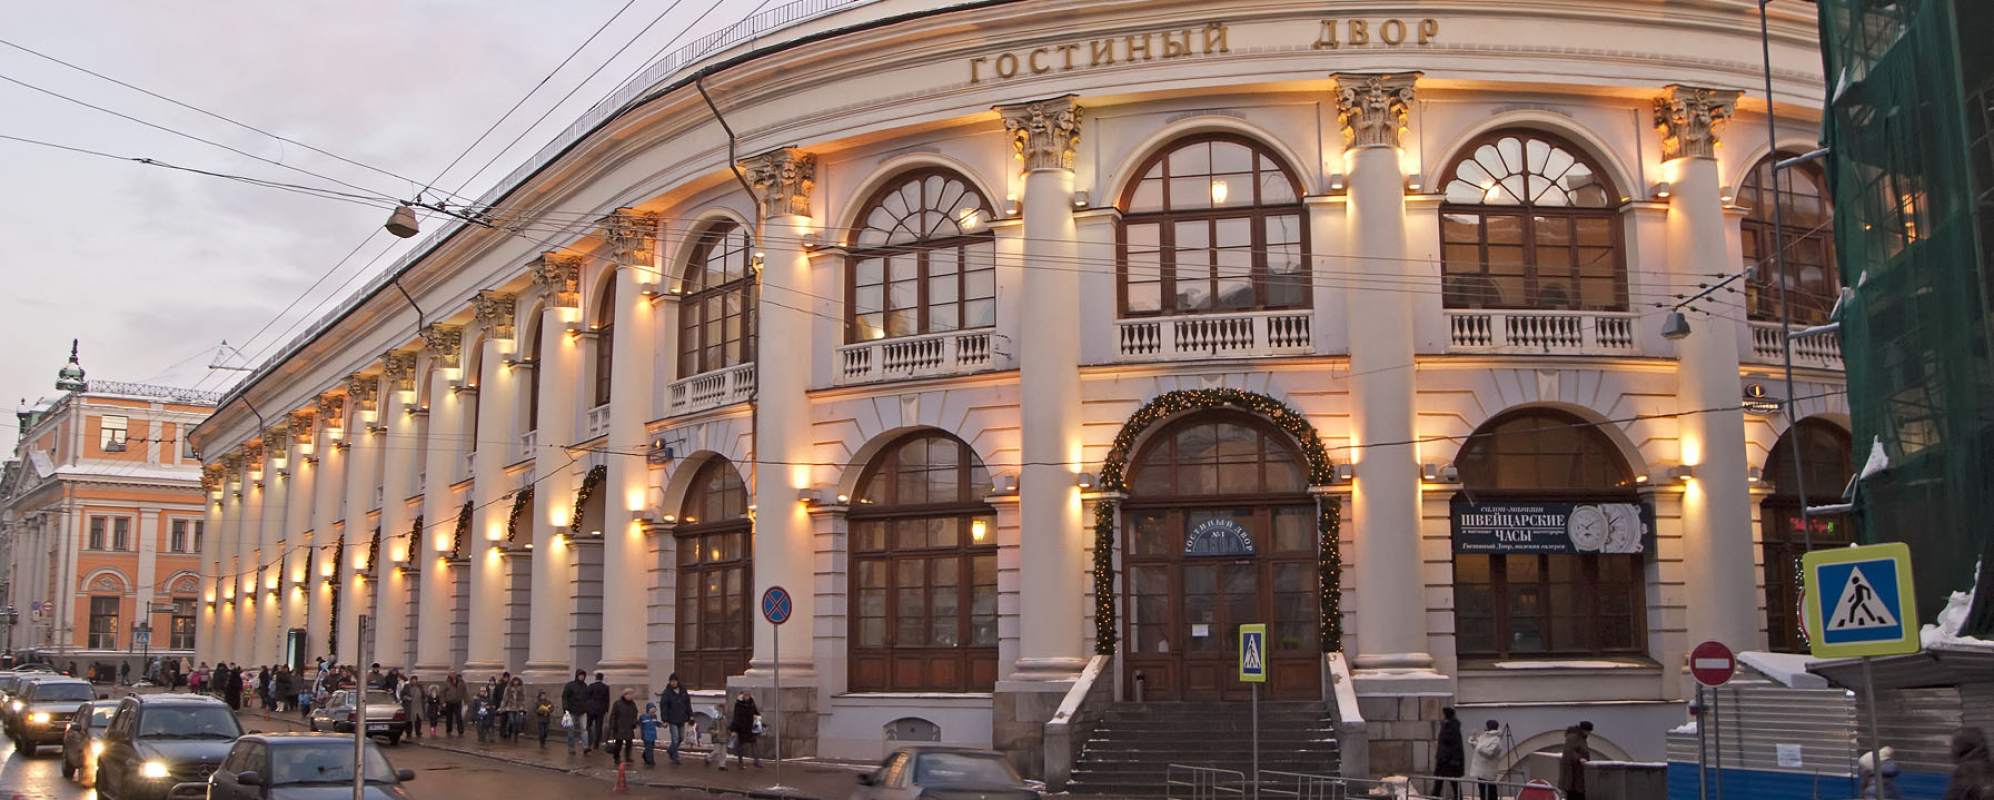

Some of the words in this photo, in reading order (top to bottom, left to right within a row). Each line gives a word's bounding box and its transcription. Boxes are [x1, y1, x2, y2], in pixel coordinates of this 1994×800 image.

[970, 21, 1230, 84] ГОСТИНЫЙ
[1313, 18, 1440, 50] ДВОР
[1461, 512, 1565, 529] ШВЕЙЦАРСКИЕ
[1185, 519, 1233, 553] ГОСТИНЫЙ
[1234, 526, 1253, 551] ДВОР
[1495, 529, 1531, 542] ЧАСЫ
